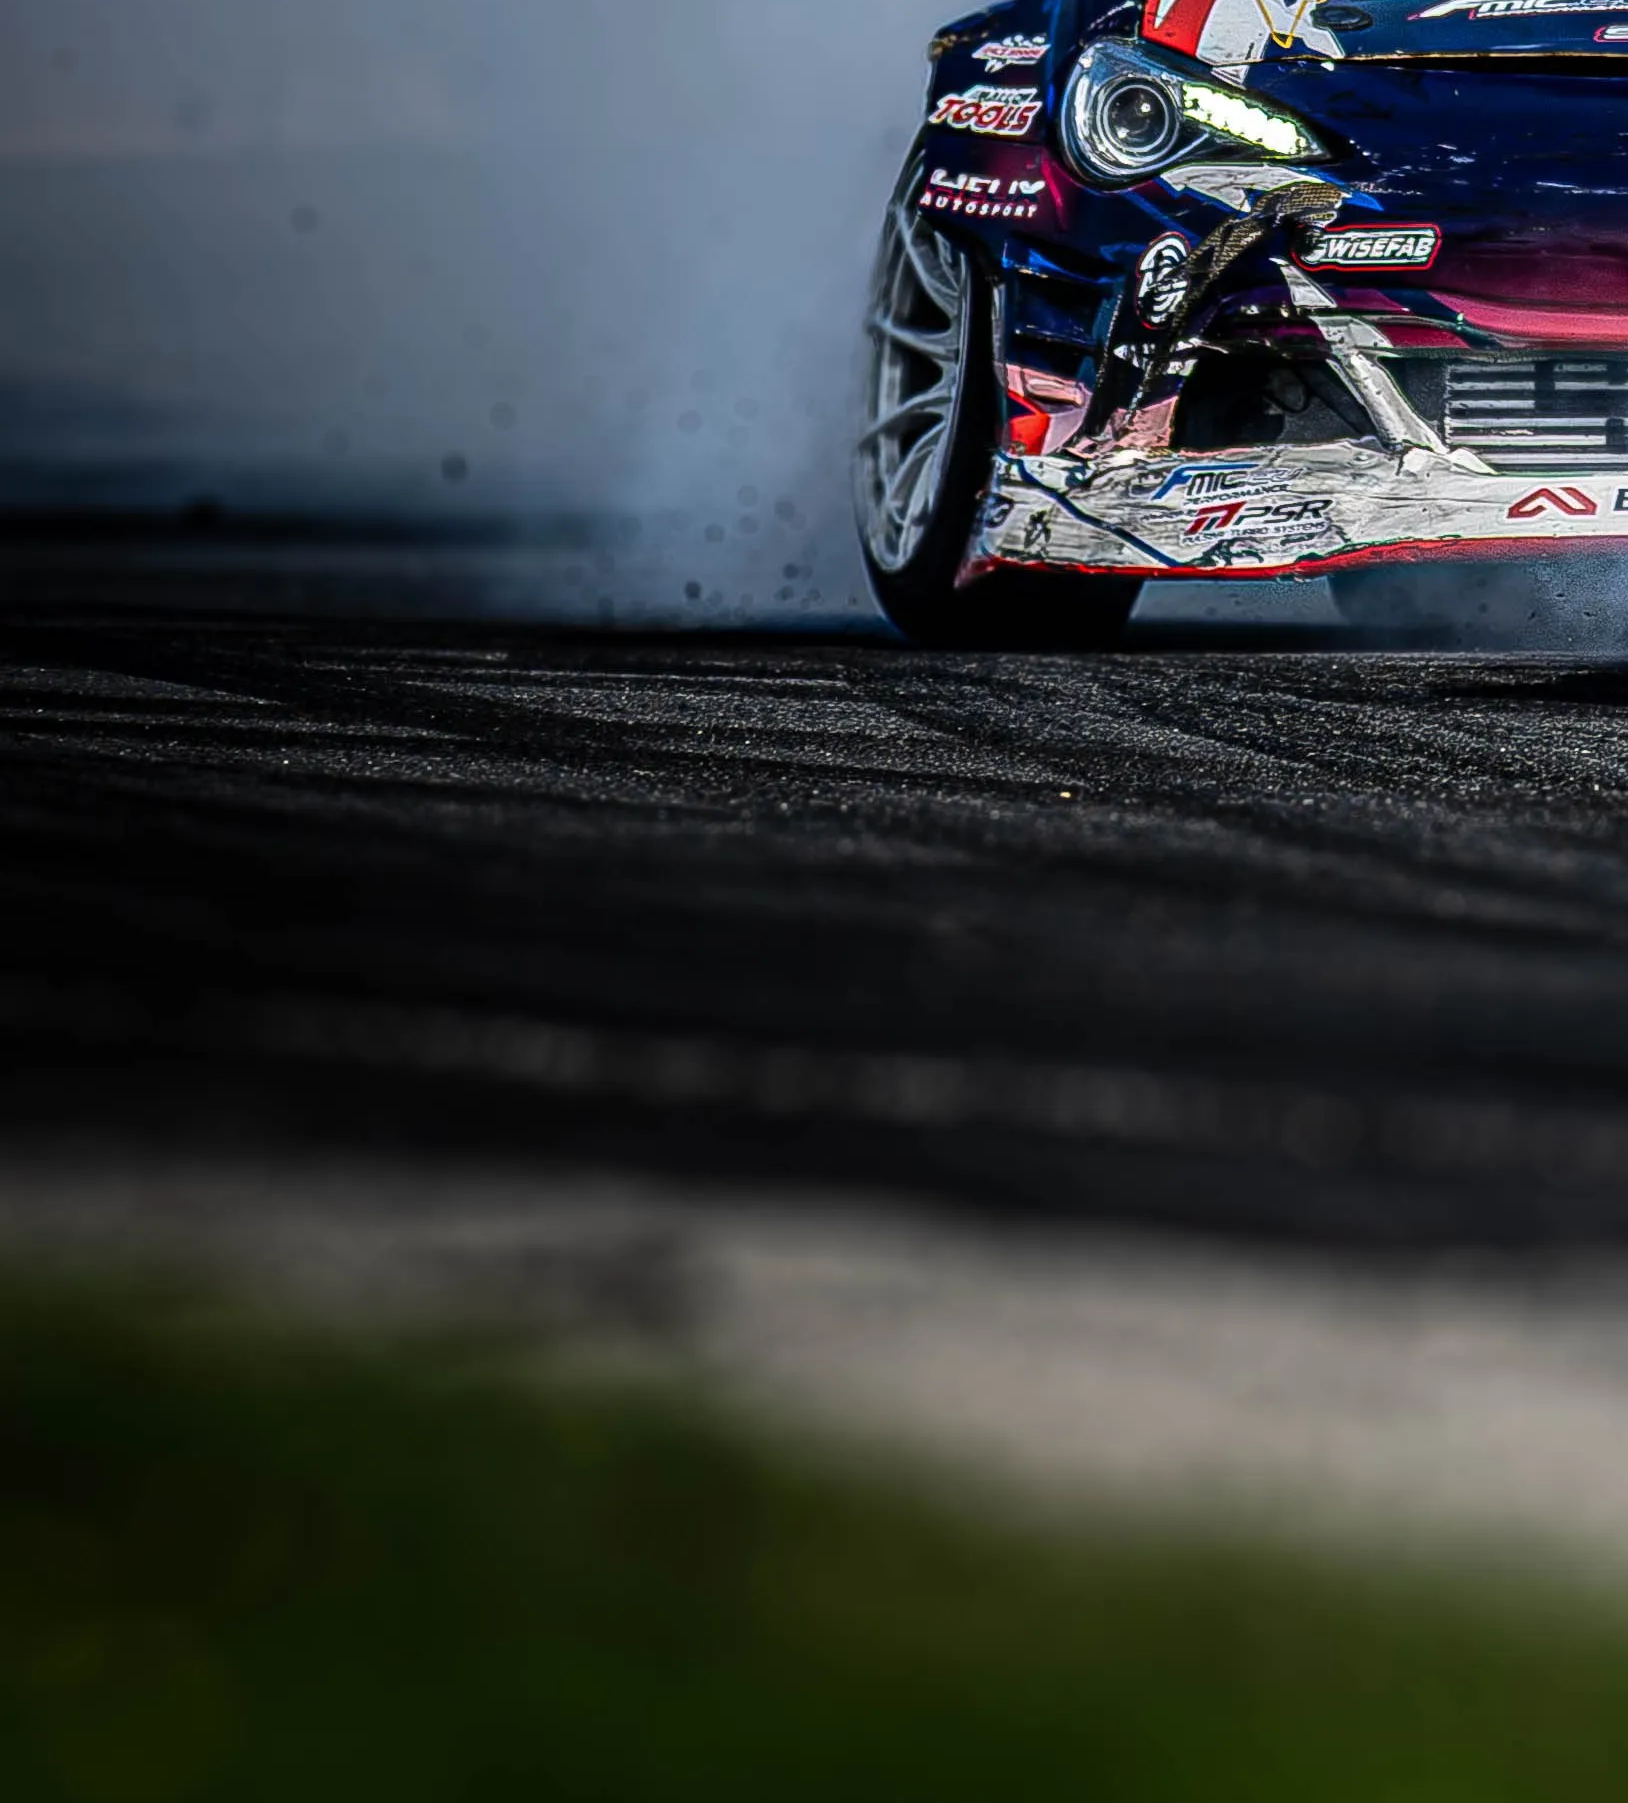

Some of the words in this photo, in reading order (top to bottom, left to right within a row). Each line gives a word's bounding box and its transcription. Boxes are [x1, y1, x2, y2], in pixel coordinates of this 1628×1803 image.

[931, 96, 1039, 133] TOOLS
[919, 191, 1039, 218] AUTOSPORT
[1183, 483, 1290, 506] PERFORMANCE
